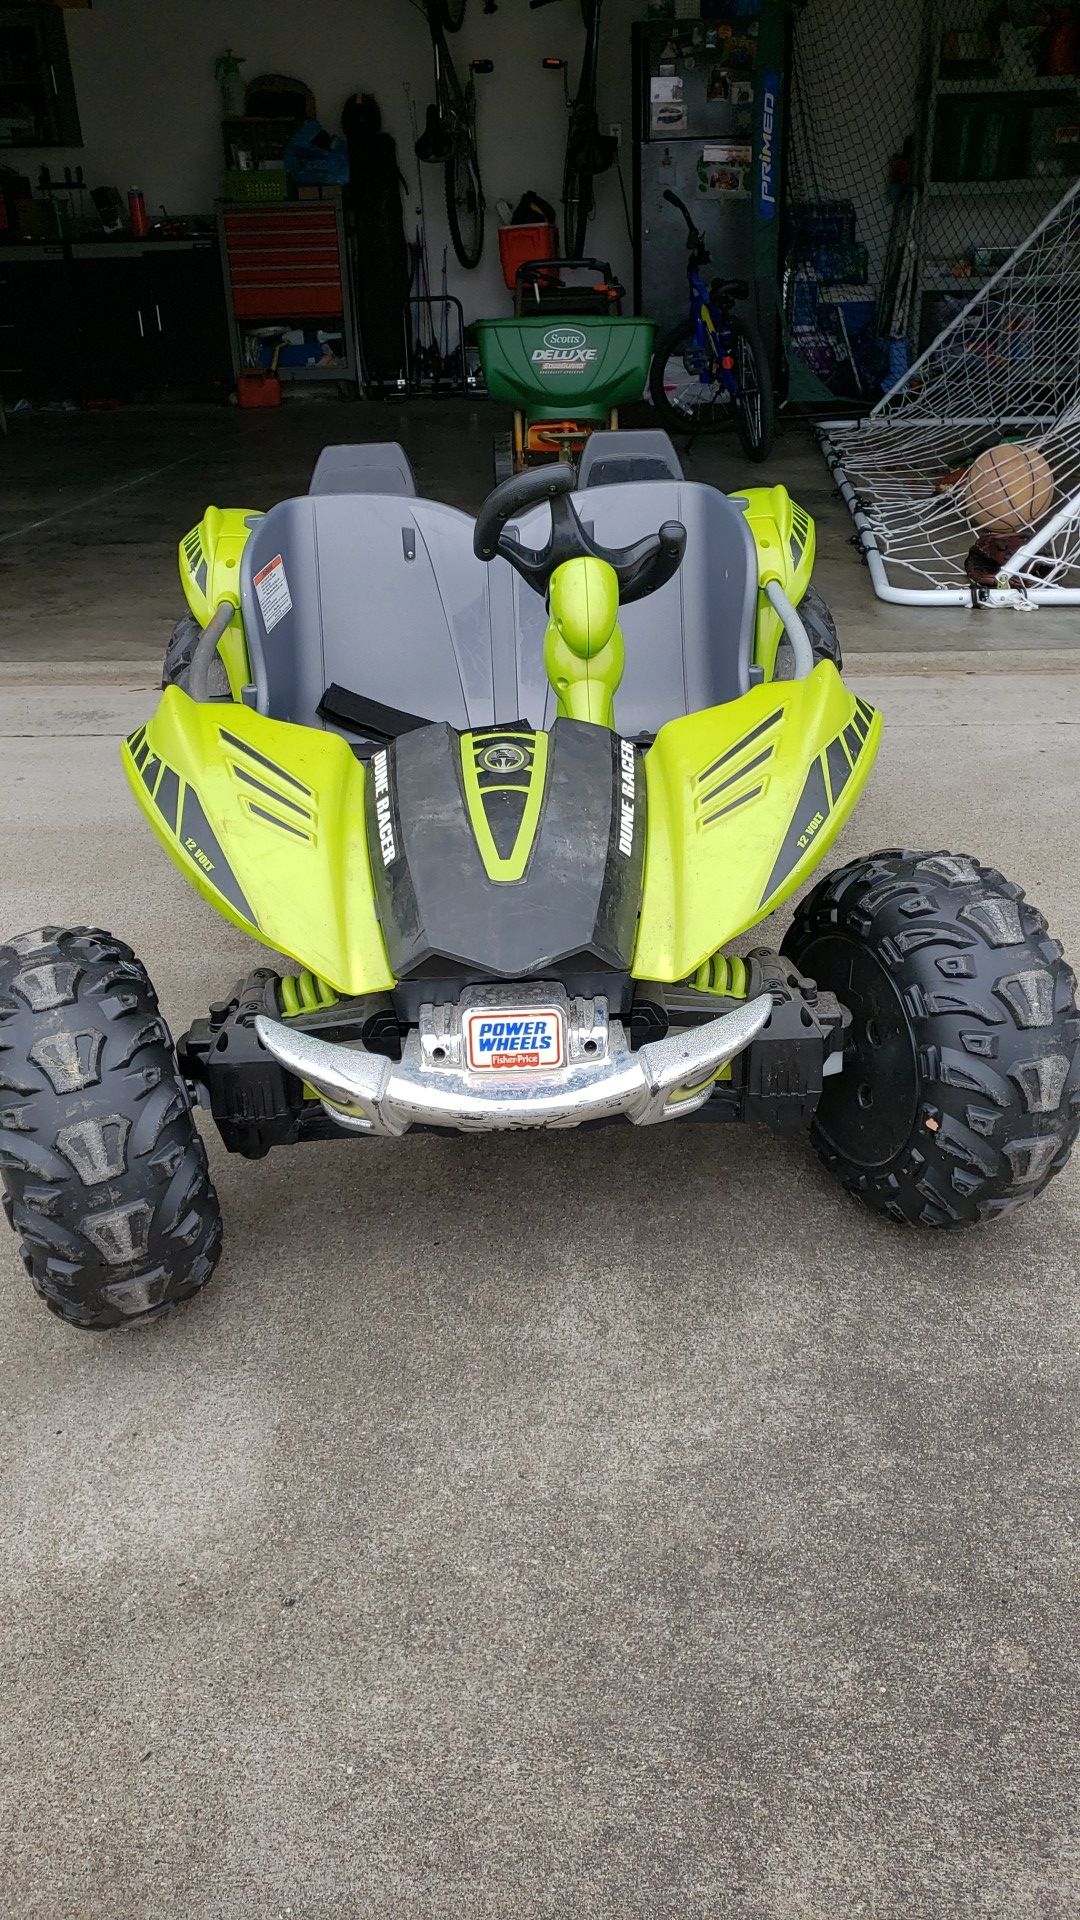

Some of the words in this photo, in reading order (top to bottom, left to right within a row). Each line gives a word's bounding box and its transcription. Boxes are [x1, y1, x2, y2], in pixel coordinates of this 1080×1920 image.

[531, 349, 597, 362] DELUXE
[550, 333, 580, 344] Scotts
[374, 749, 389, 798] DUNE
[621, 739, 636, 800] RACER
[376, 796, 396, 867] RACER
[619, 799, 635, 858] DUNE
[796, 834, 810, 849] 12
[805, 811, 824, 836] VOLT
[184, 837, 197, 851] 12
[194, 848, 216, 872] VOLT
[479, 1021, 547, 1037] POWER
[479, 1036, 553, 1052] WHEELS
[492, 1054, 539, 1065] Fisher-Price
